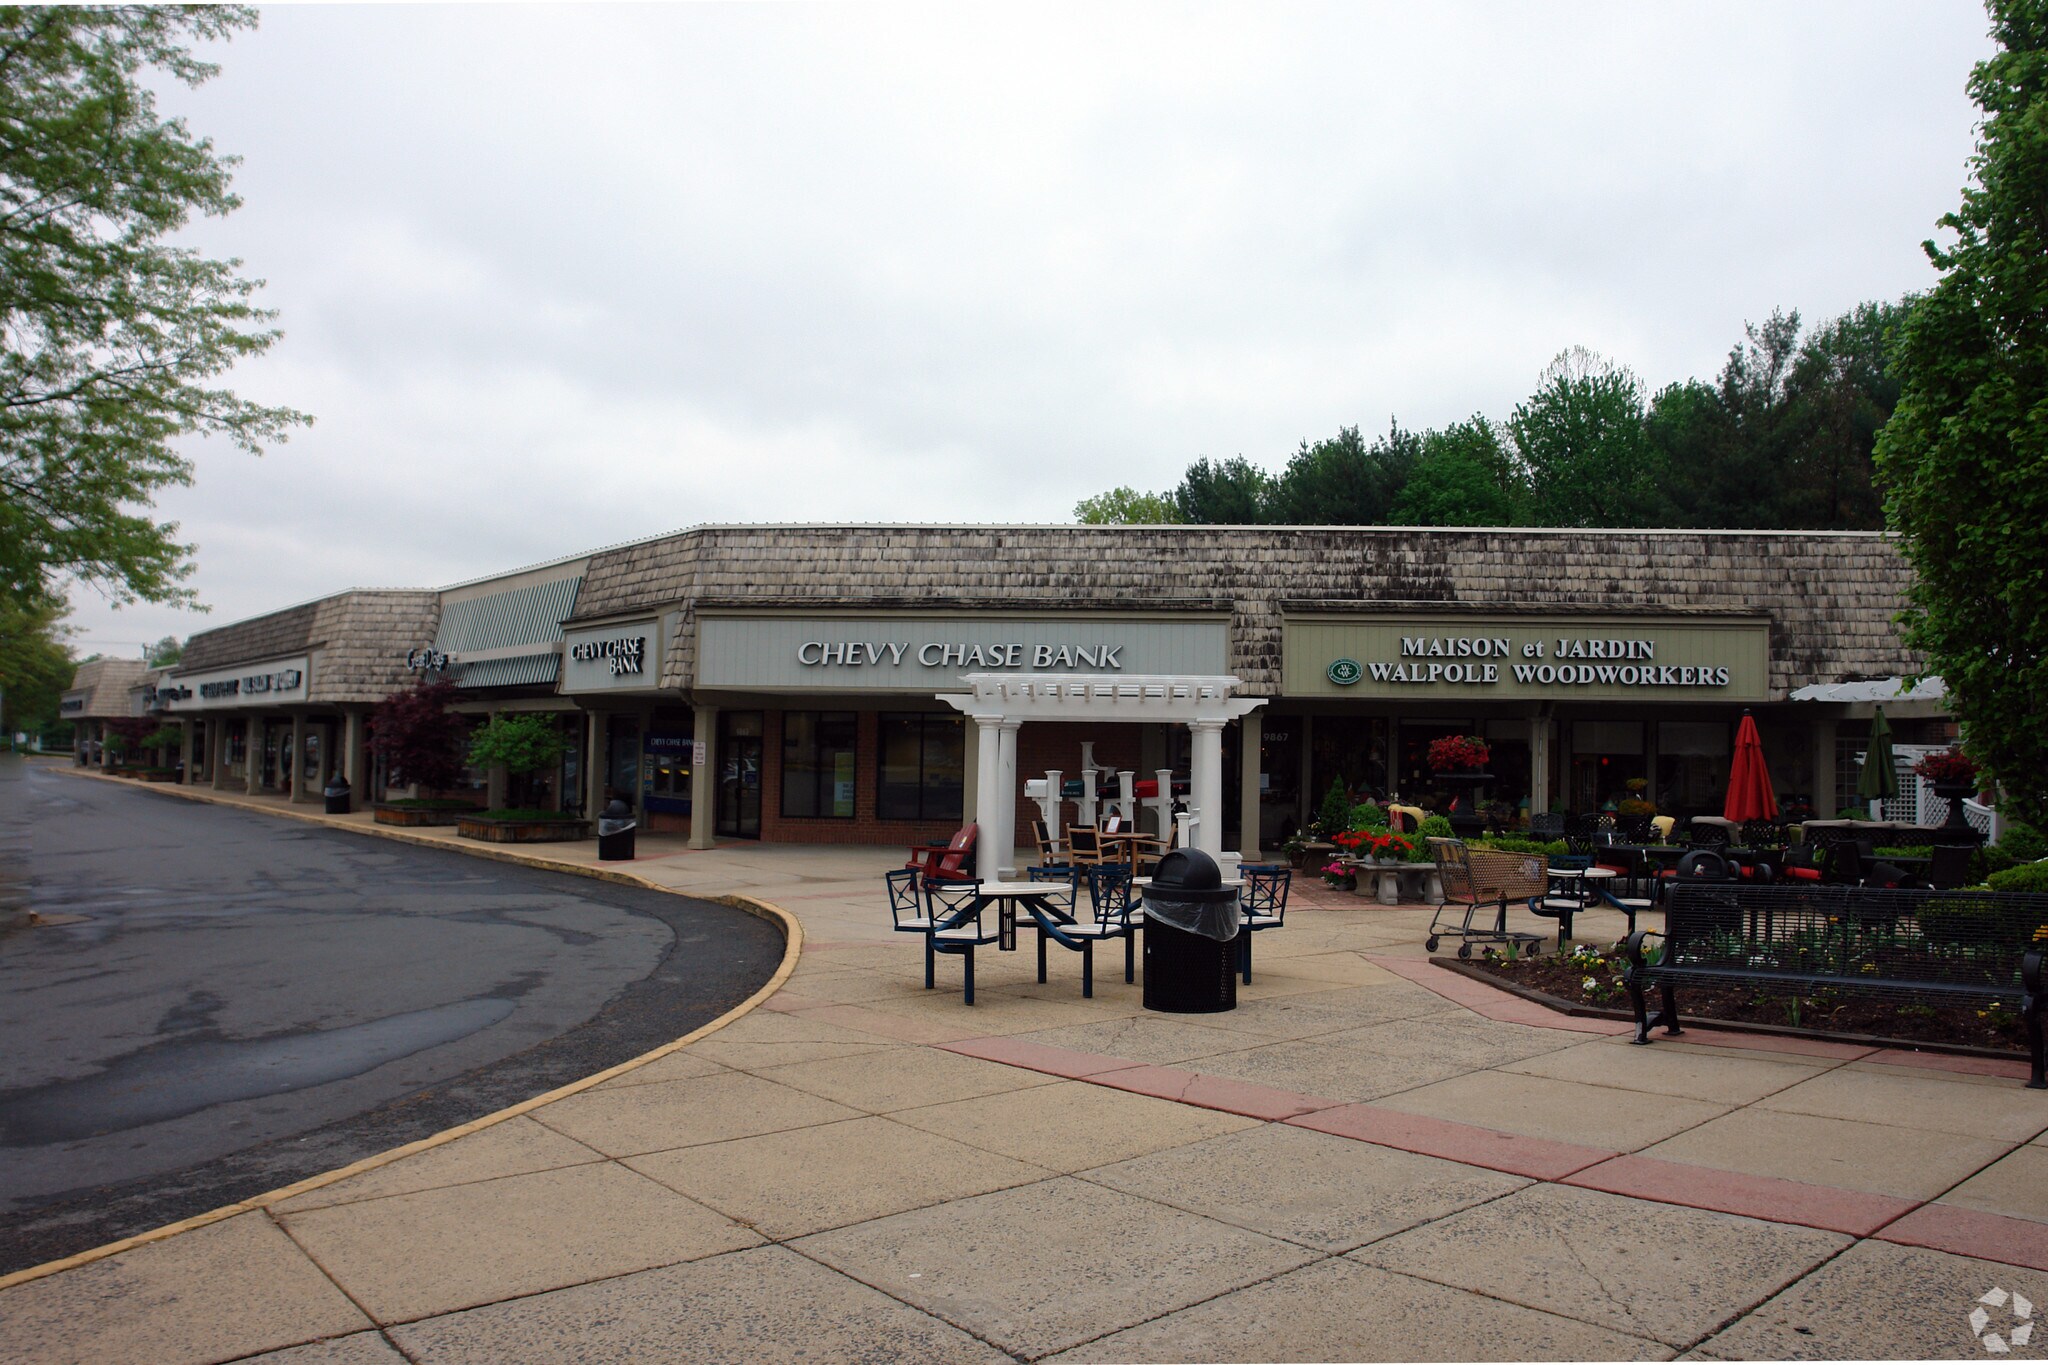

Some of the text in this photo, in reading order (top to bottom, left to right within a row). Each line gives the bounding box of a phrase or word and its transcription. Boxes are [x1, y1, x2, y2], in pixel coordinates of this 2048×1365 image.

[571, 637, 642, 660] CHEVY CHASE
[797, 641, 1123, 669] CHEVY CHASE BANK
[1401, 637, 1656, 660] MAISON et JARDIN
[609, 655, 640, 675] BANK
[1367, 662, 1500, 683] WALPOLE
[1511, 664, 1731, 686] WOODWORKERS
[1263, 732, 1289, 742] 9867
